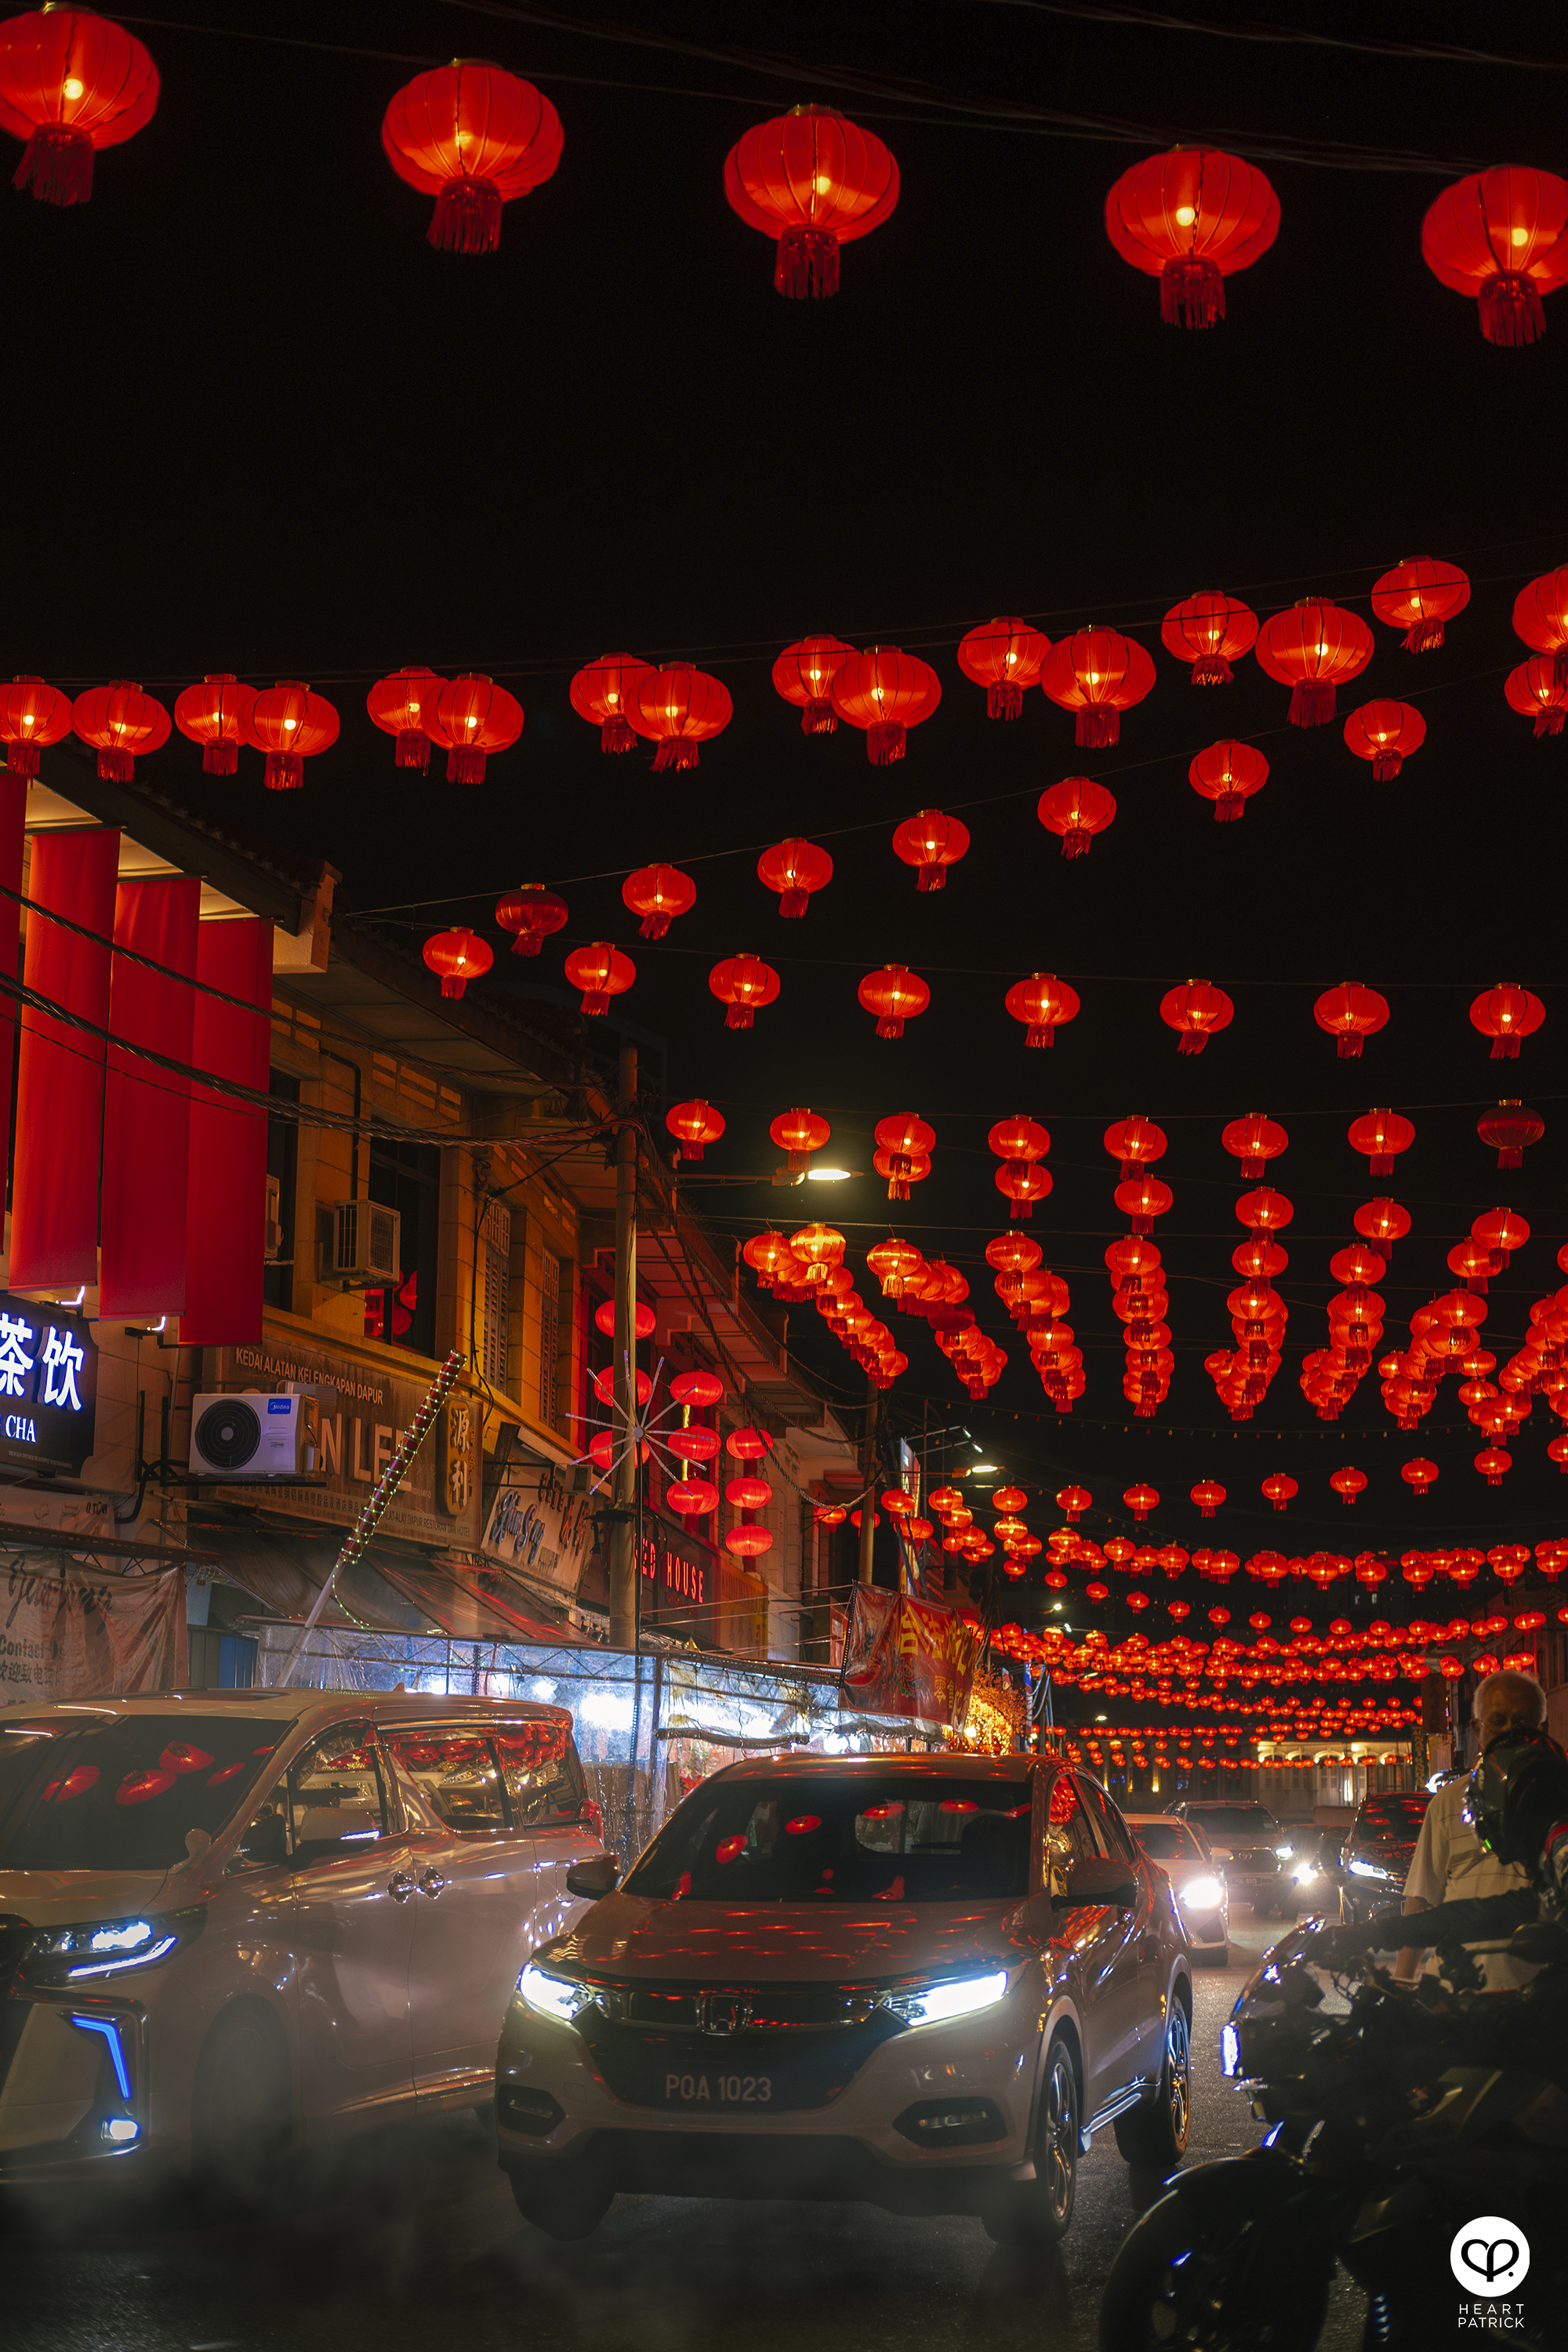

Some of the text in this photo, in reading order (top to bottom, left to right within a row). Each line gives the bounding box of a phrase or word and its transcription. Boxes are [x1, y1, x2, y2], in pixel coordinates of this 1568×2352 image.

[235, 1347, 383, 1405] KEDAI ALATAN KELENGKAPAN DAPUR
[271, 1402, 290, 1410] Midea
[5, 1414, 37, 1443] CHA
[407, 1514, 423, 1528] DAPUR
[423, 1518, 447, 1533] RESTORAN
[457, 1525, 470, 1537] HOTEL
[666, 1551, 704, 1604] HOUSE
[666, 2074, 771, 2101] PQA 1023
